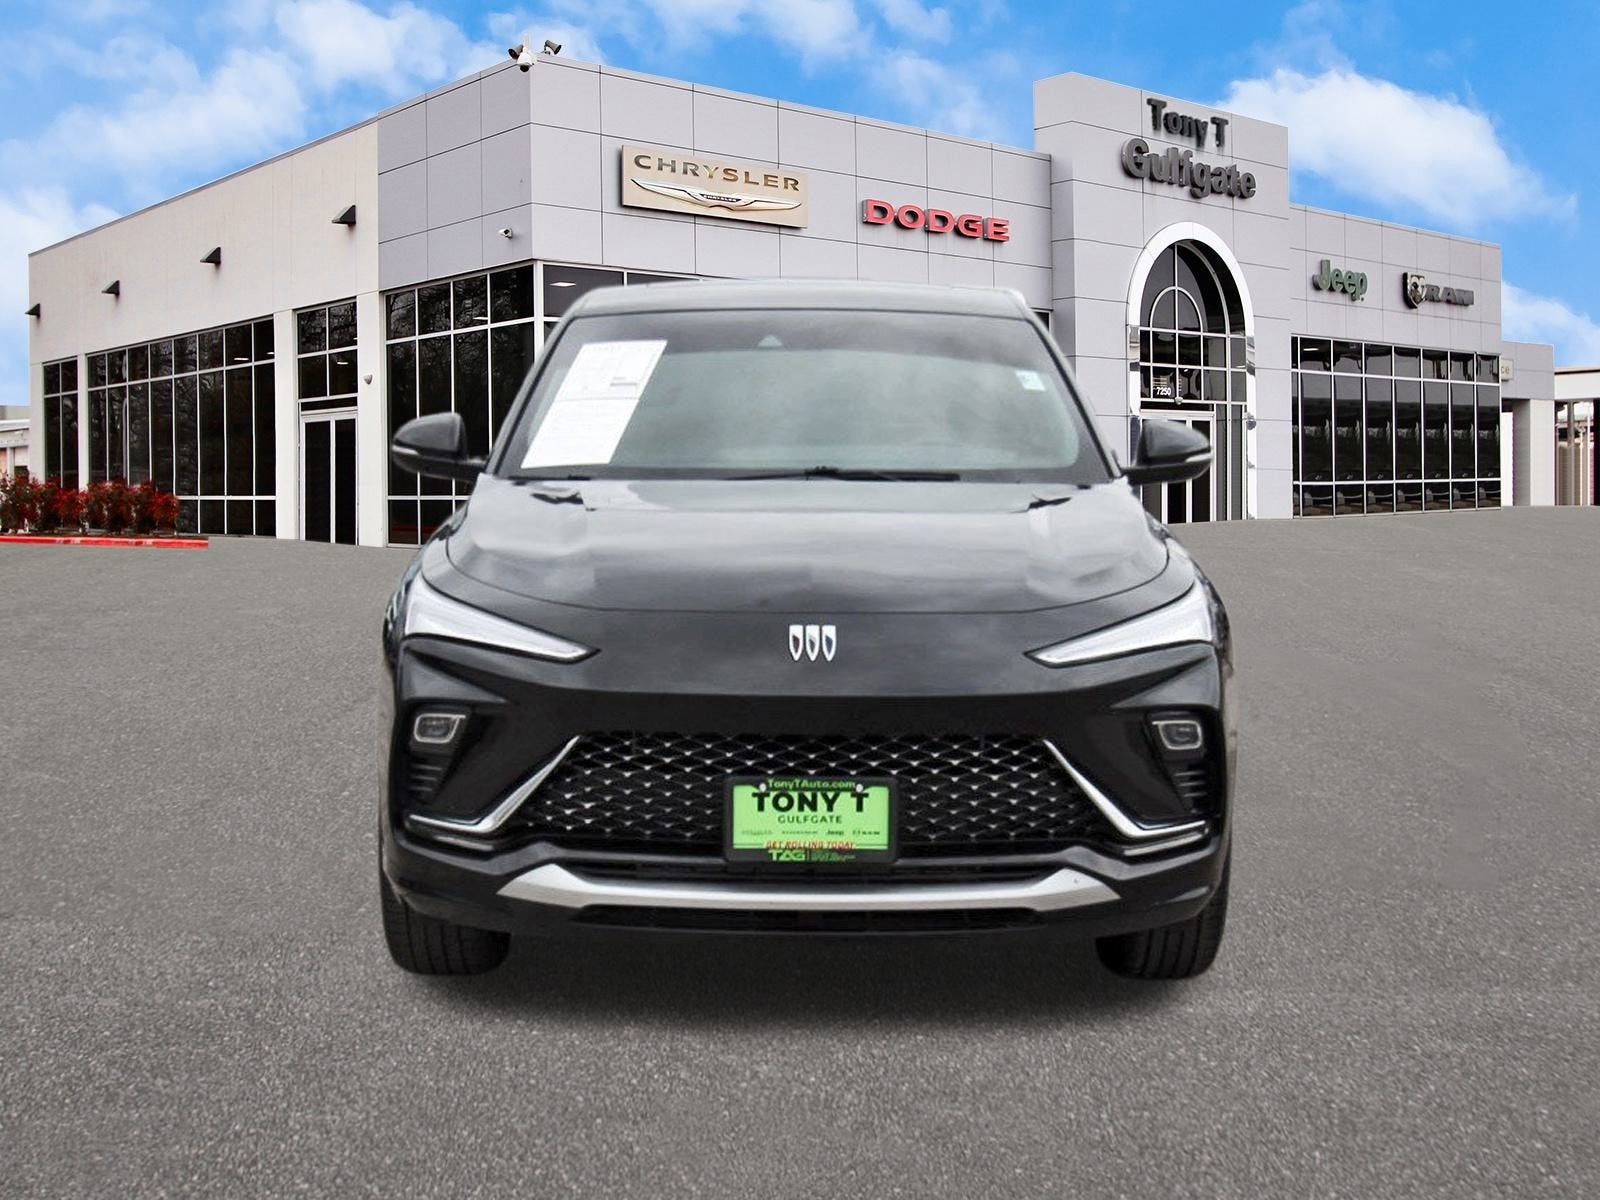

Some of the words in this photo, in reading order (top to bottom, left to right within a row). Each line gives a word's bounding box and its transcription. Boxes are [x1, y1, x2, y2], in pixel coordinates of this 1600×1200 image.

[1146, 98, 1208, 147] Tony
[1210, 116, 1229, 147] T
[634, 154, 800, 192] CHRYSLER
[1121, 138, 1256, 198] Gulfgate
[863, 199, 1010, 242] DODGE
[1312, 260, 1368, 301] Jeep
[1425, 284, 1475, 306] RAM
[752, 792, 840, 812] TONY
[850, 792, 869, 812] T
[767, 778, 856, 789] TonyTAuto.com
[778, 815, 843, 824] GULFGATE
